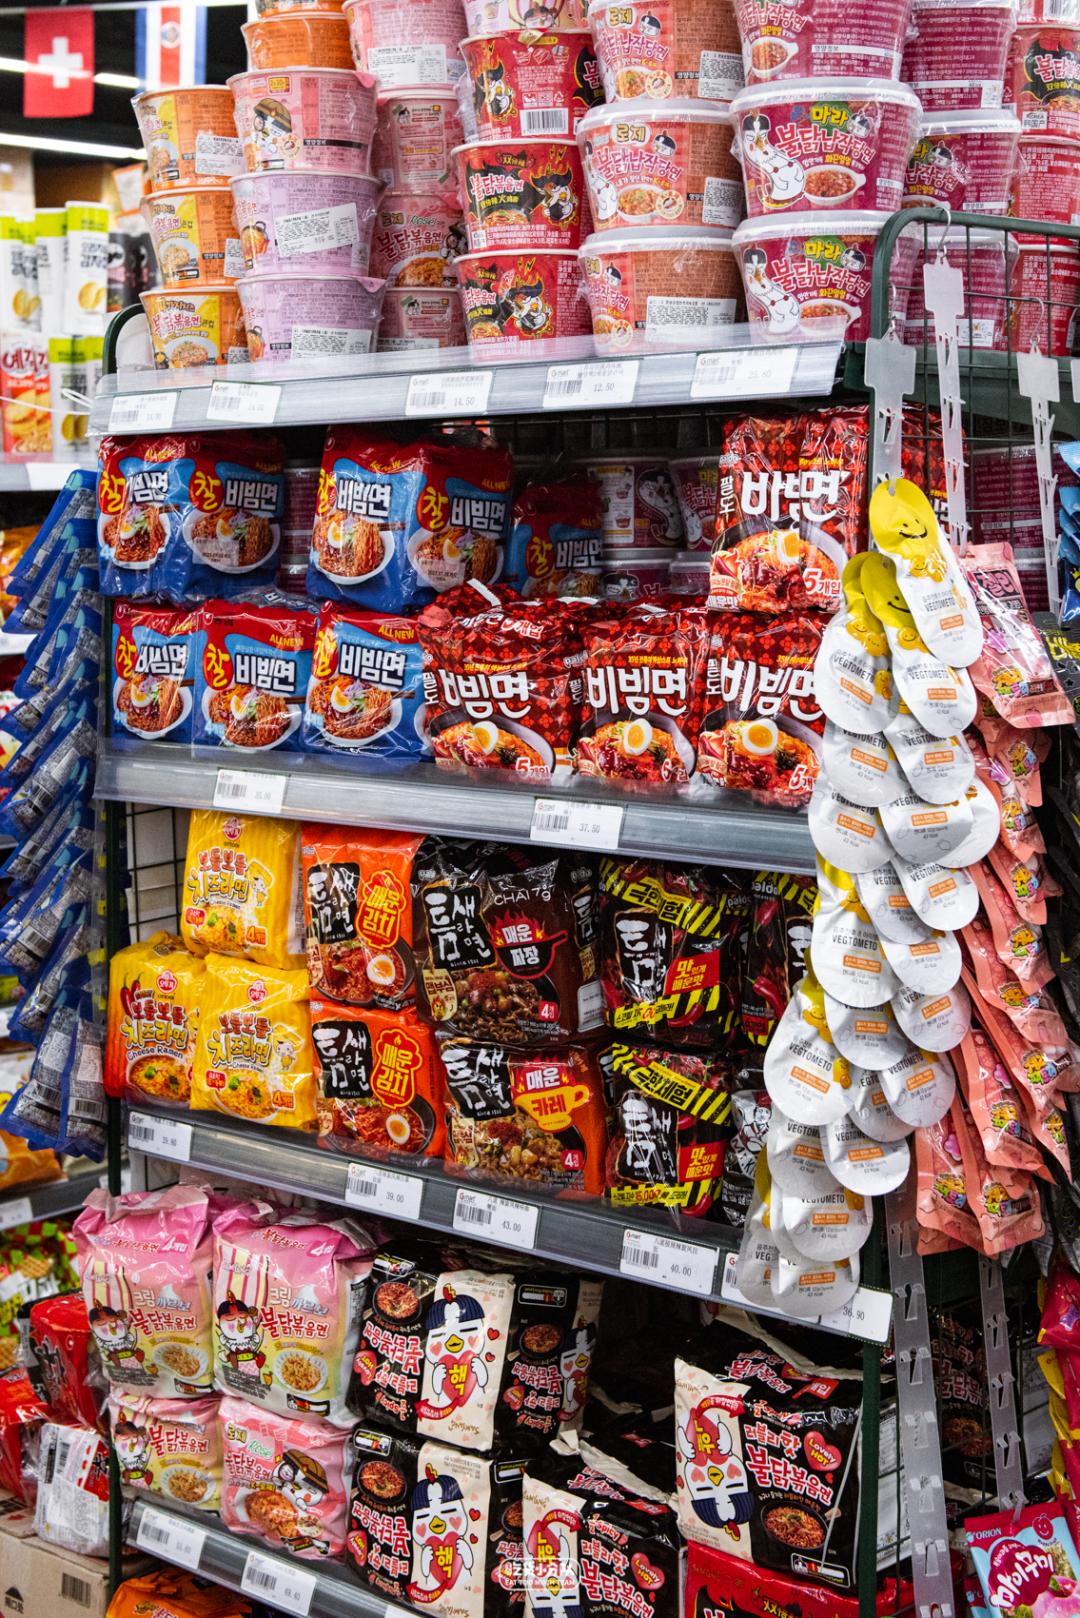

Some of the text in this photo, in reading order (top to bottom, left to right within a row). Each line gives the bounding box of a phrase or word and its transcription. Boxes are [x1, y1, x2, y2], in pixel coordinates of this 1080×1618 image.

[811, 106, 849, 126] 마라
[615, 124, 645, 143] 로제
[775, 123, 876, 165] 불닭납작당면
[805, 241, 841, 262] 마라
[771, 258, 870, 298] 불닭납작당면
[194, 471, 279, 511] 찰 비빔면
[336, 477, 391, 518] 비빔면
[423, 486, 506, 533] 찰 비빔면
[531, 537, 553, 577] 찰
[819, 580, 842, 595] 개입
[118, 635, 137, 678] 찰
[206, 642, 297, 694] 찰 비빔면
[339, 643, 407, 687] 비빔면
[586, 664, 688, 717] 비빔면
[721, 655, 823, 722] 비빔면
[579, 823, 600, 834] 37.50
[199, 847, 248, 875] 보들보들
[187, 871, 249, 904] 치즈라면
[367, 886, 399, 912] 매운
[364, 911, 394, 938] 김치
[425, 892, 492, 963] 틈새라면
[502, 923, 533, 944] 매운
[510, 945, 541, 967] 짜장
[832, 934, 879, 952] VEGTOMETO
[131, 1000, 188, 1025] 보들보들
[219, 1013, 272, 1040] 보들보들
[120, 1017, 189, 1050] 치즈라면
[208, 1030, 272, 1068] 치즈라면
[128, 1045, 184, 1061] Cheese Ramen
[312, 1028, 371, 1091] 틈새라면
[382, 1042, 414, 1076] 매운
[788, 1042, 834, 1072] VEGTOMETO
[376, 1065, 410, 1097] 김치
[440, 1047, 512, 1111] 틈새라면
[525, 1066, 560, 1091] 매운
[630, 1066, 694, 1110] 극한체험
[531, 1093, 568, 1117] 카레
[386, 1191, 405, 1203] 39.00
[501, 1219, 522, 1233] 43.00
[670, 1263, 692, 1277] 40.00
[269, 1287, 292, 1308] 크림
[843, 1306, 865, 1320] 36.90
[130, 1307, 197, 1337] 불닭볶음면
[262, 1307, 331, 1340] 불닭볶음면
[362, 1320, 424, 1376] 불닭볶음면
[449, 1364, 468, 1396] 핵
[148, 1424, 209, 1458] 불닭볶음면
[743, 1420, 802, 1459] 러블리 핫
[808, 1438, 837, 1464] Lovely
[810, 1449, 829, 1467] HOT
[746, 1443, 834, 1505] 불닭볶음면
[352, 1500, 411, 1557] 불닭볶음면
[975, 1527, 1002, 1540] ORION
[435, 1545, 453, 1578] 핵
[581, 1538, 612, 1564] 러블리
[635, 1559, 660, 1584] Lovely
[637, 1569, 655, 1586] HOT
[990, 1549, 1054, 1608] 마이구미
